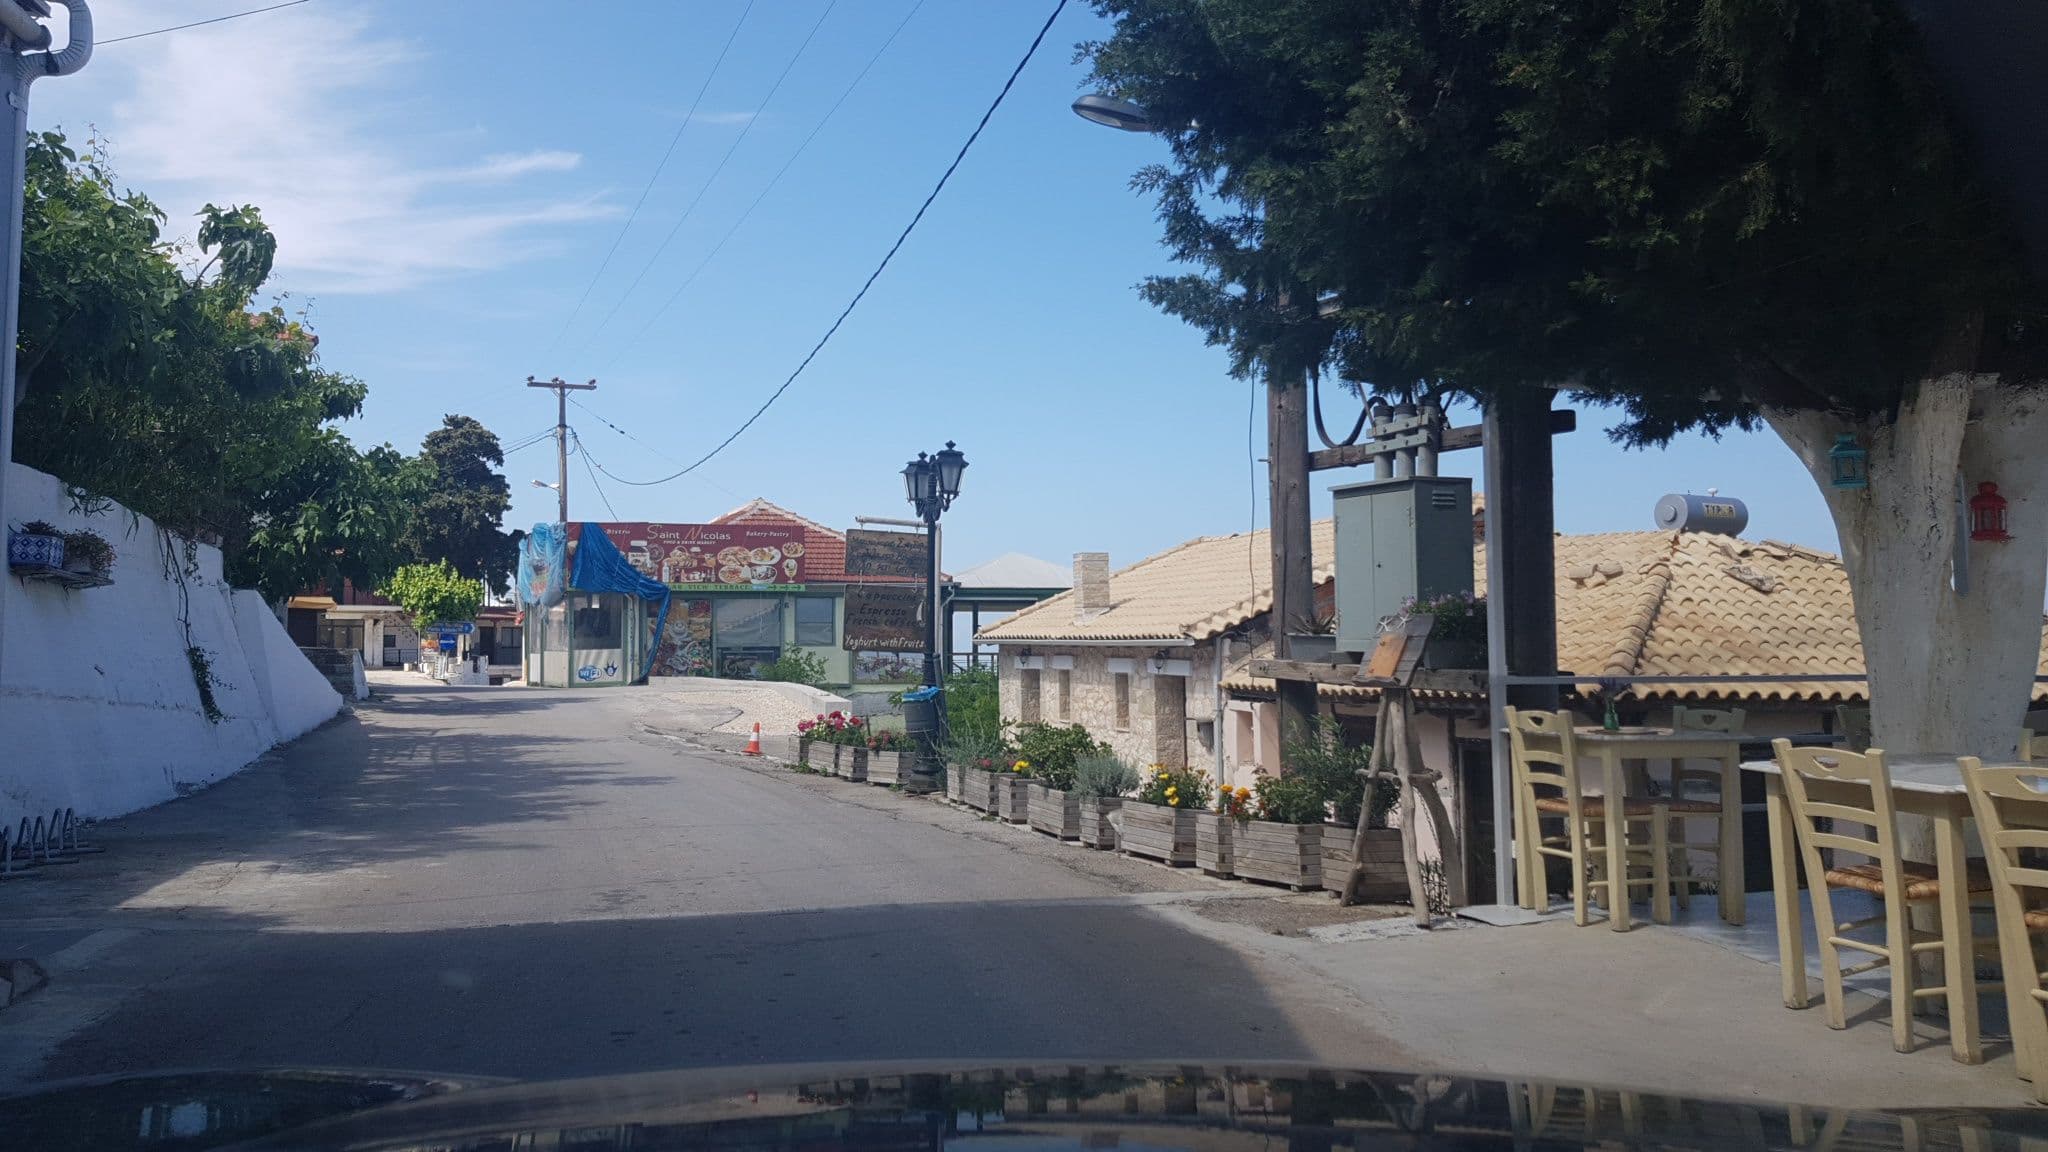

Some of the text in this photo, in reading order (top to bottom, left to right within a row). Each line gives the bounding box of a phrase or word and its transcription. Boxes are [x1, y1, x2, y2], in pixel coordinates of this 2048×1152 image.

[647, 524, 731, 541] Saint Nicolas
[859, 603, 907, 616] Espresso
[846, 612, 878, 626] French
[845, 633, 878, 650] Yoghurt
[879, 636, 898, 648] with
